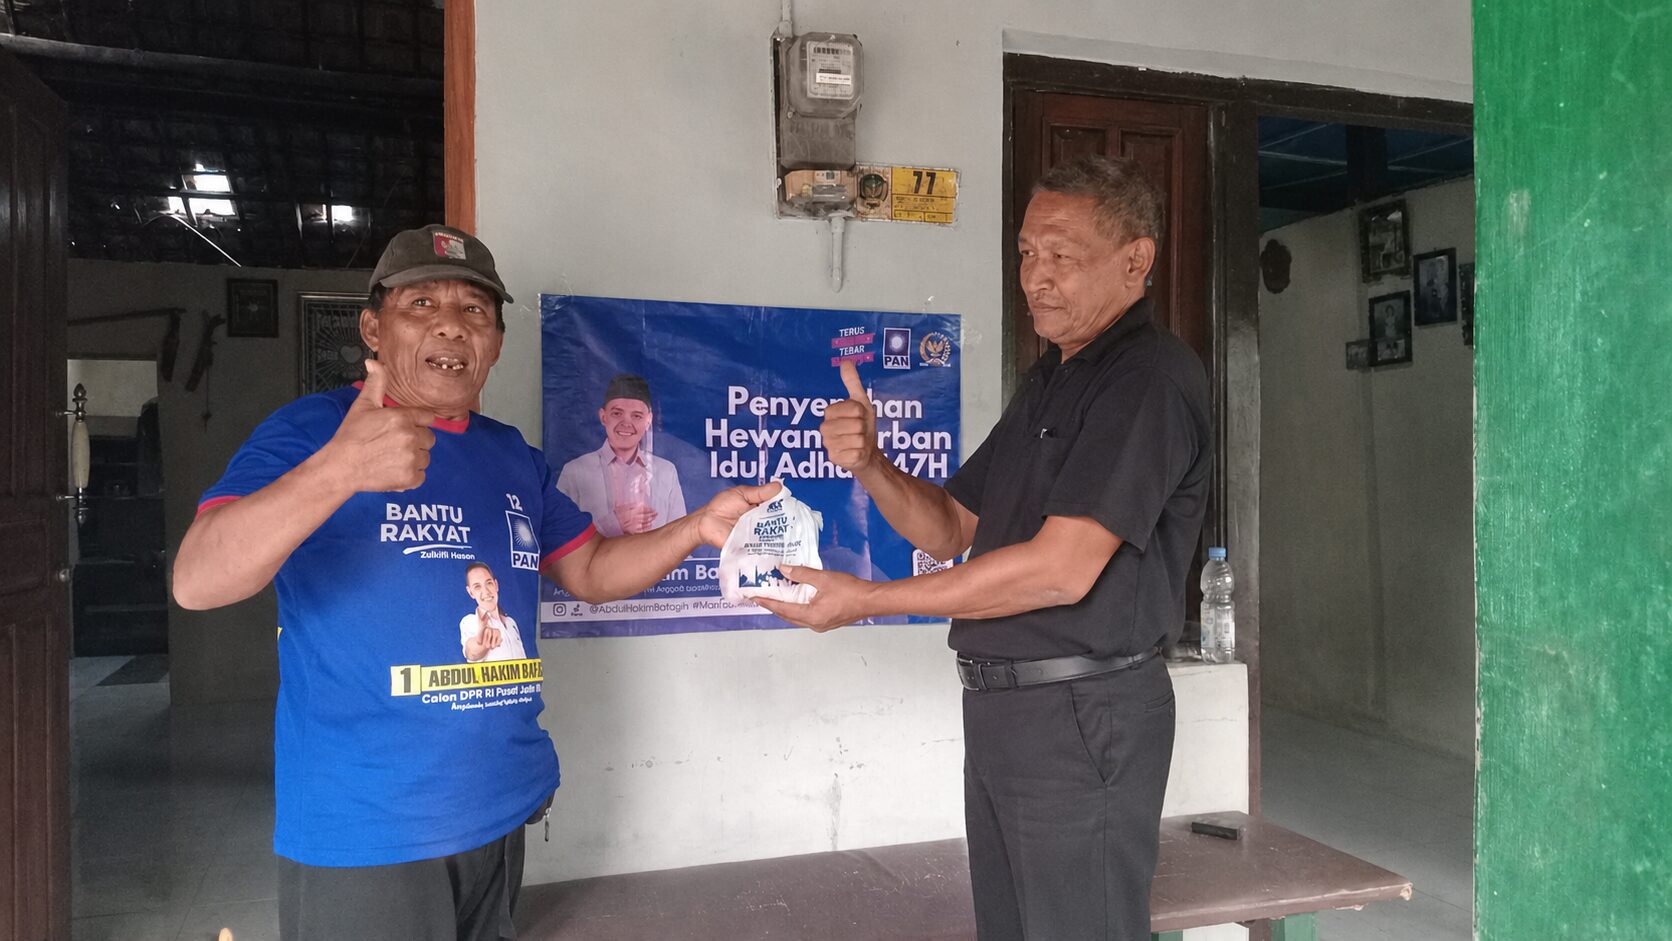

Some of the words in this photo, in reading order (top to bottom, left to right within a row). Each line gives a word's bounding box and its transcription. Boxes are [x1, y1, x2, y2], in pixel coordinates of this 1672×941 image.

[913, 170, 936, 195] 77
[839, 327, 865, 337] TERUS
[839, 345, 865, 357] TEBAR
[884, 356, 909, 366] PAN
[705, 418, 822, 449] Hewan
[710, 451, 766, 478] Idul
[506, 493, 523, 511] 12
[386, 502, 463, 523] BANTU
[380, 523, 470, 544] RAKYAT
[513, 553, 539, 569] PAN
[400, 667, 412, 694] 1
[428, 667, 479, 687] ABDUL
[481, 663, 521, 683] HAKIM
[422, 693, 457, 704] Calon
[460, 688, 483, 700] DPR
[485, 688, 494, 698] RI
